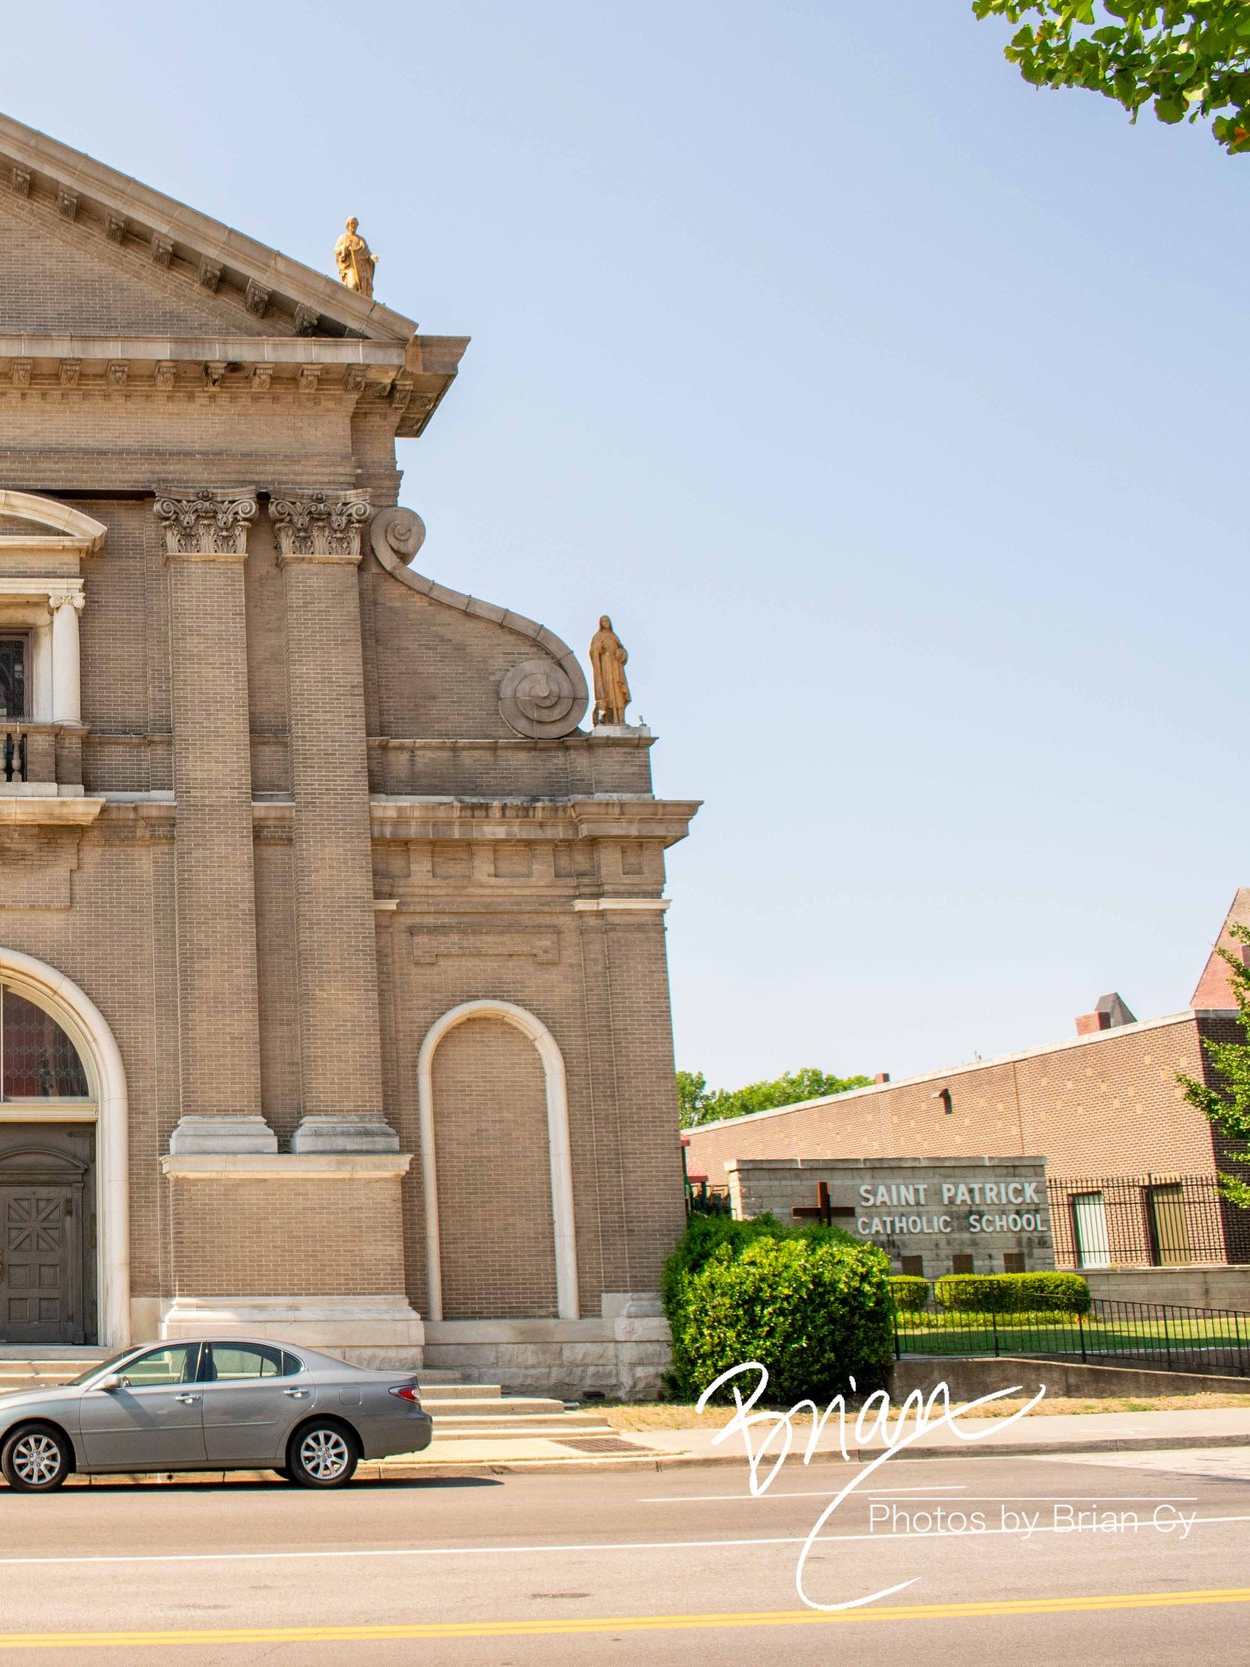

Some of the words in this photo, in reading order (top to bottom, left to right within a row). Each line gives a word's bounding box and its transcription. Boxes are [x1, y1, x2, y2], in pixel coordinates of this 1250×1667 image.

[859, 1184, 928, 1207] SAINT
[942, 1182, 1040, 1206] PATRICK
[857, 1216, 951, 1235] CATHOLIC
[969, 1214, 1048, 1233] SCHOOL
